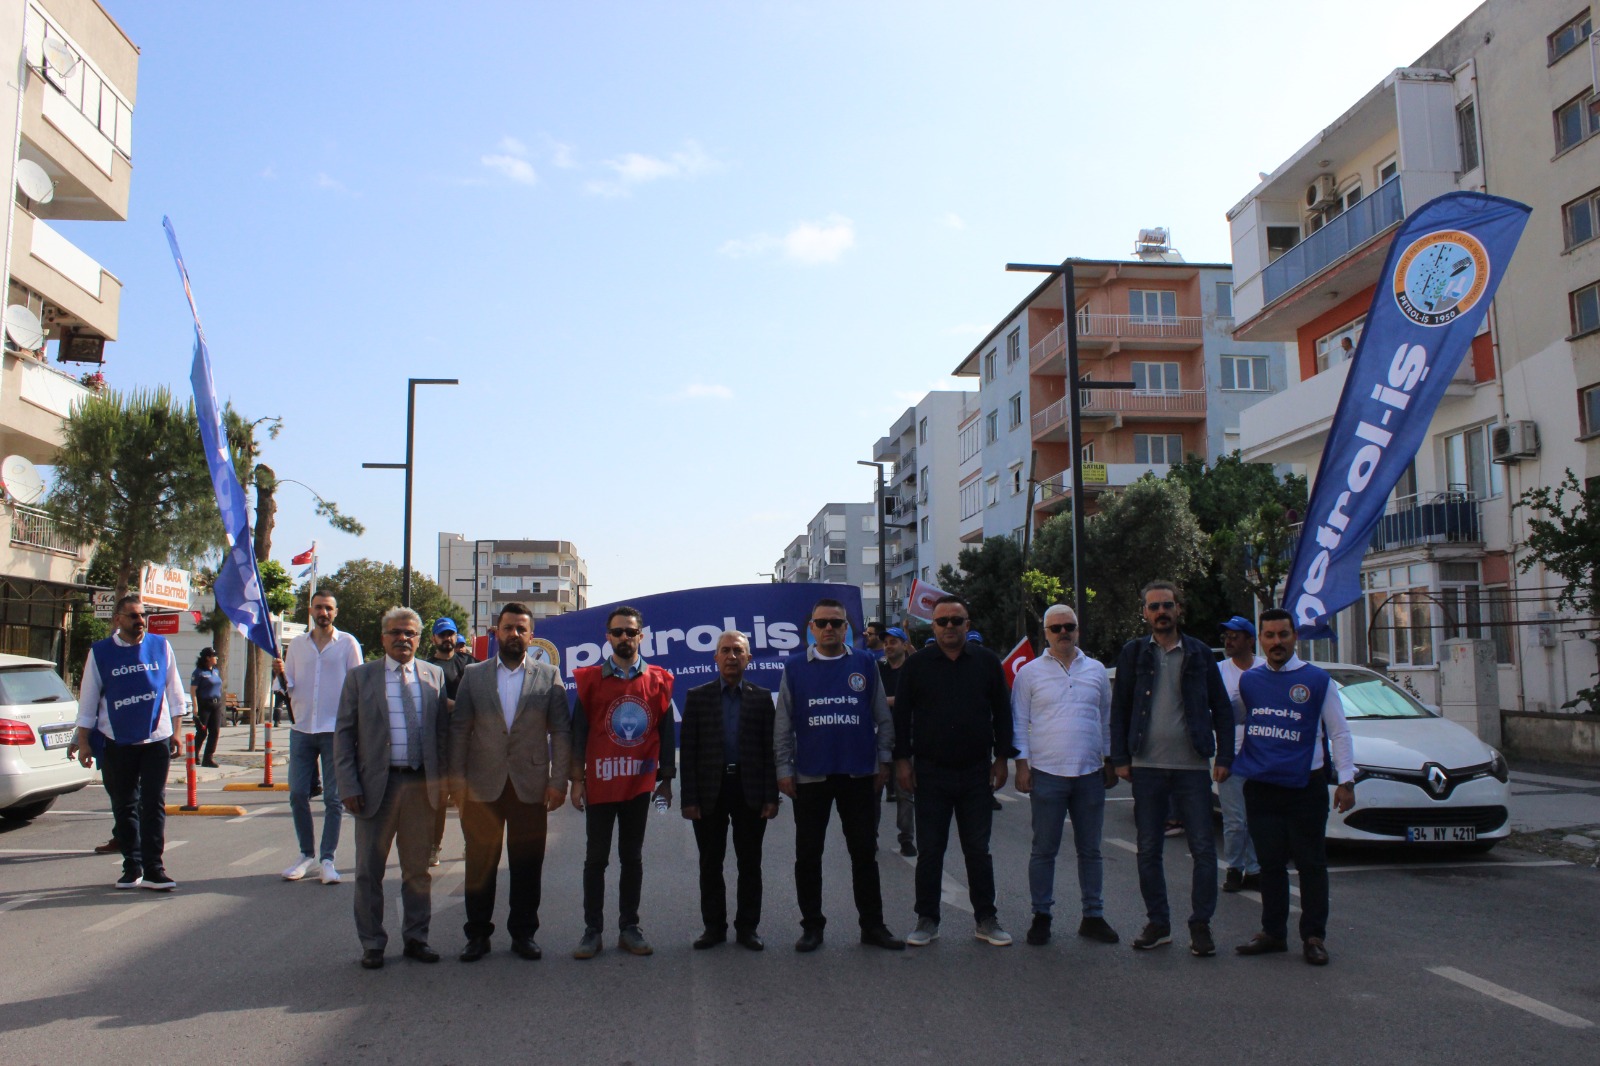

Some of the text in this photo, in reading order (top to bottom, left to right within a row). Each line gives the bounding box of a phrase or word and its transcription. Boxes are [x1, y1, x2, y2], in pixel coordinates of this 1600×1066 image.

[1399, 295, 1456, 325] PETROL-İŞ 1950
[111, 661, 159, 676] GÖREVLİ
[676, 664, 712, 675] LASTİK
[808, 713, 860, 726] SENDİKASI
[1247, 725, 1301, 742] SENDİKASI
[1413, 827, 1476, 841] 34 NY 4211
